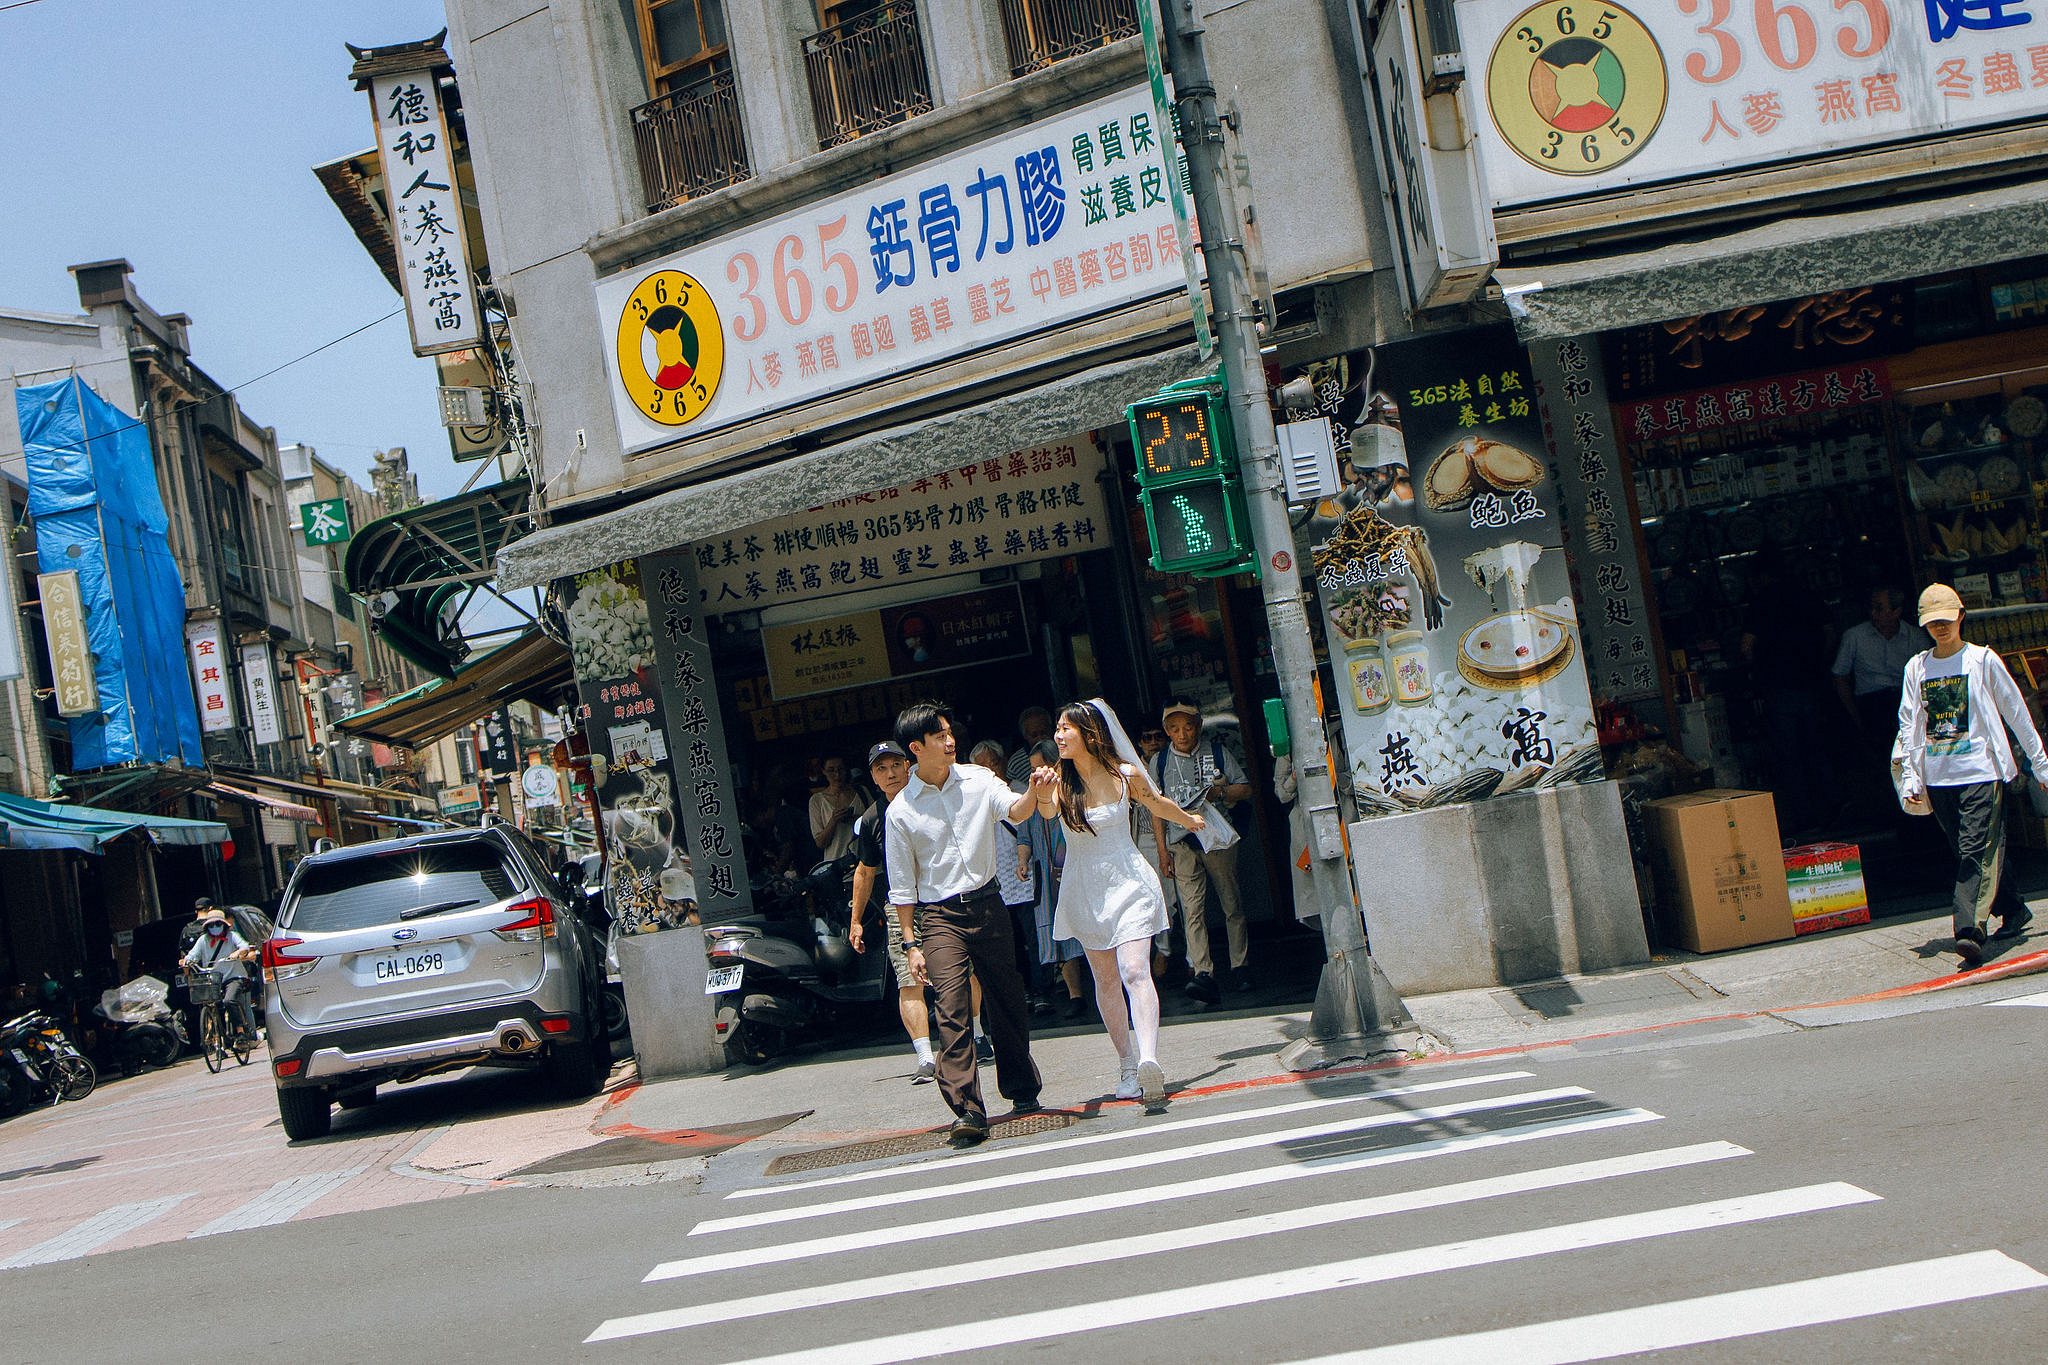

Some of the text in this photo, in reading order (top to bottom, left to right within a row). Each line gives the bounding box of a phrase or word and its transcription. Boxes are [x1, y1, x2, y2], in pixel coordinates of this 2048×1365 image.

[1517, 7, 1618, 53] 365
[1701, 92, 1783, 144] 人蔘
[1814, 73, 1902, 124] 燕窩
[1540, 117, 1635, 163] 365
[388, 84, 461, 331] 德和人蔘燕窩
[726, 145, 1066, 342] 365 鈣骨力膠
[632, 278, 693, 321] 365
[746, 351, 783, 395] 人蔘
[794, 333, 840, 378] 燕窩
[850, 314, 897, 361] 鮑翅
[909, 296, 954, 344] 蟲草
[967, 276, 1015, 324] 靈芝
[650, 375, 707, 417] 365
[1409, 371, 1523, 407] 365法自然
[1458, 396, 1530, 428] 養生坊
[1633, 368, 1884, 440] 蔘茸燕窩漢方養生
[1146, 405, 1210, 473] 23
[308, 503, 345, 541] 茶
[773, 519, 859, 556] 排便順暢
[994, 481, 1085, 519] 骨骼保健
[1470, 488, 1546, 529] 鮑魚
[775, 563, 821, 595] 燕窩
[829, 555, 884, 586] 鮑翅
[892, 544, 940, 575] 靈芝
[948, 534, 994, 566] 蟲草
[1321, 548, 1411, 590] 冬蟲夏草
[657, 567, 740, 900] 德和蔘藥燕窩鮑翅
